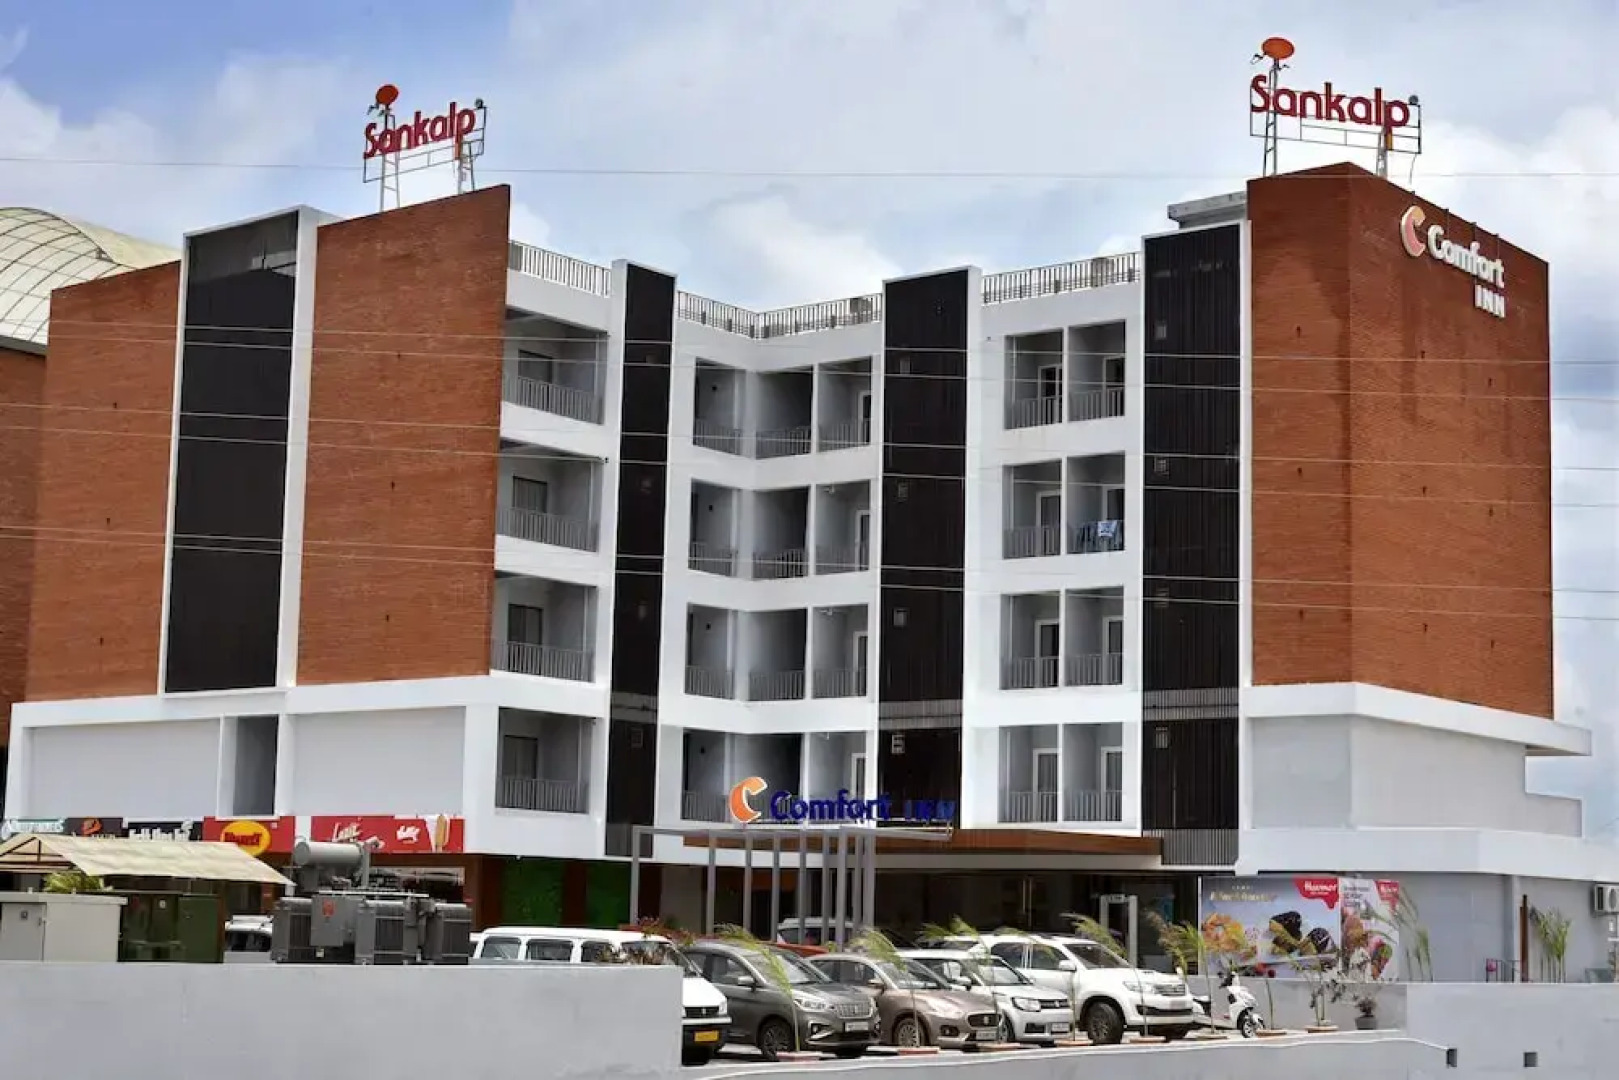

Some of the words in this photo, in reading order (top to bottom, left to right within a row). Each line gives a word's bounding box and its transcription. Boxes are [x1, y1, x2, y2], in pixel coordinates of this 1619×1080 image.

[363, 101, 476, 160] Sankalp
[1250, 74, 1411, 150] Sankalp
[1427, 224, 1505, 289] Comfort
[1474, 284, 1506, 318] INN
[770, 788, 892, 820] Comfort
